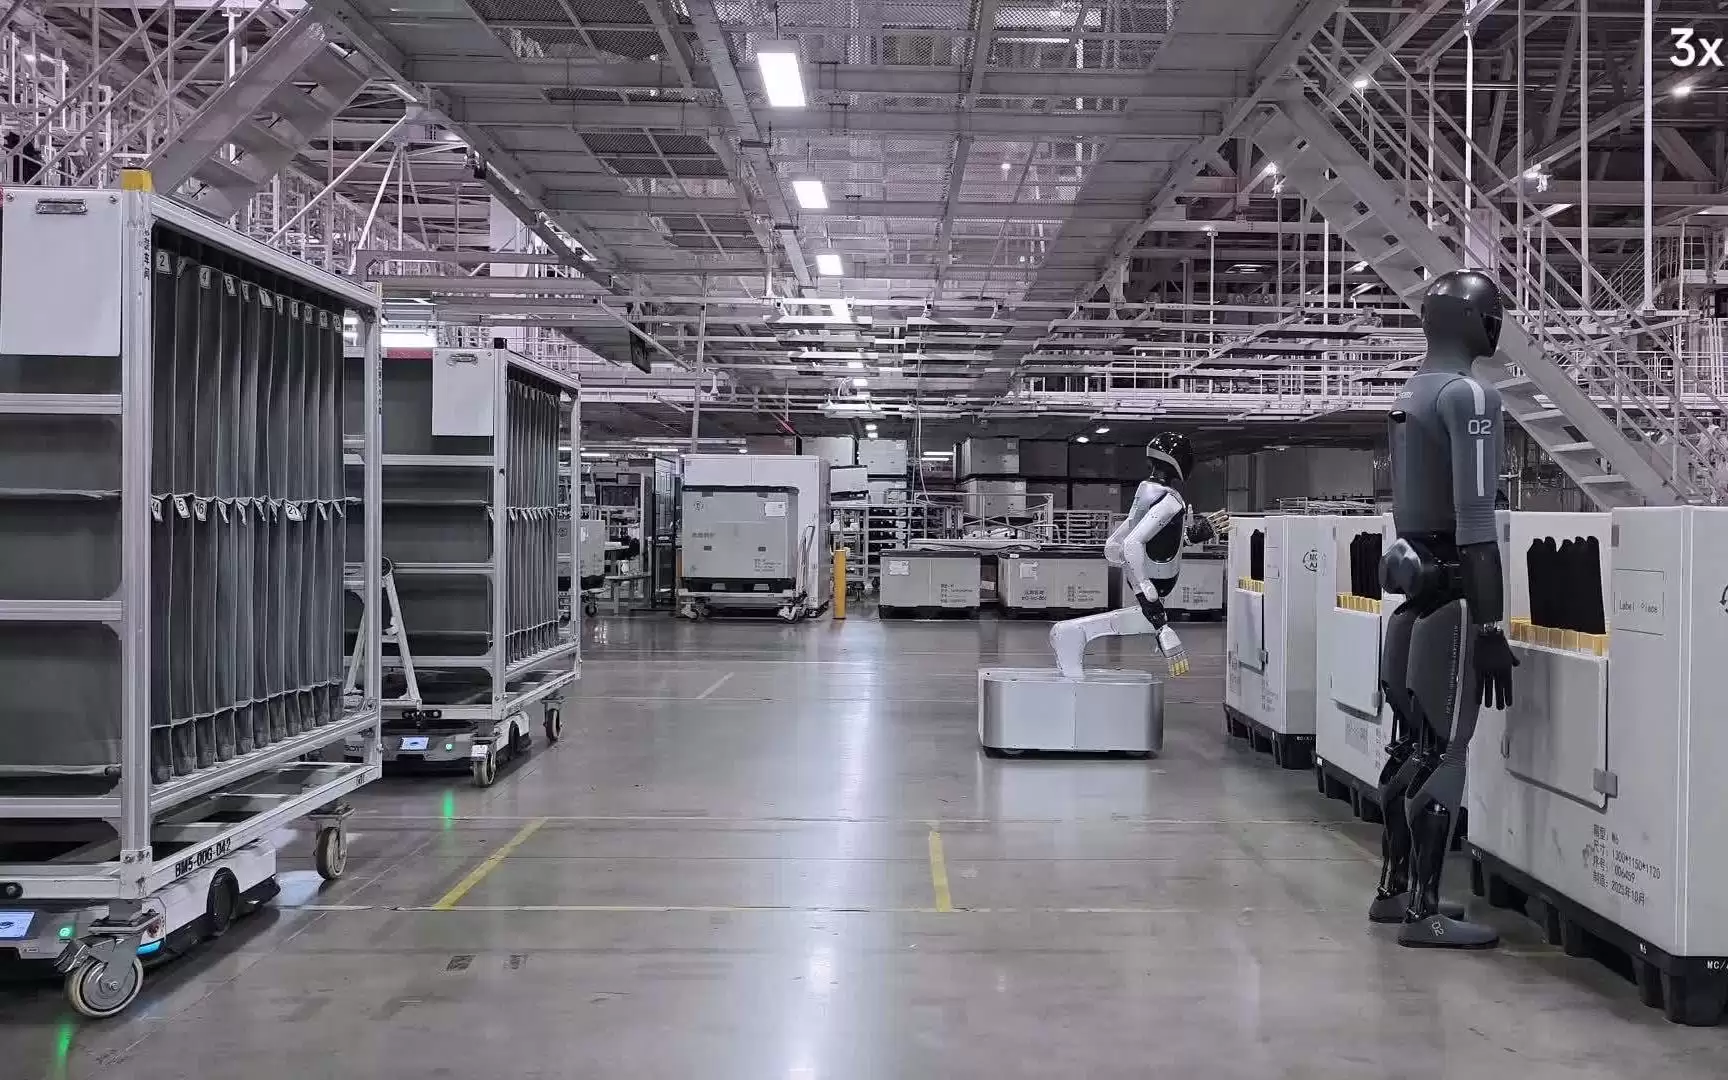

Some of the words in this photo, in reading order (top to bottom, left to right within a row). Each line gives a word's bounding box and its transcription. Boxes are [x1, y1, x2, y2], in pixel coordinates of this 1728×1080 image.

[159, 254, 165, 267] 2
[1468, 419, 1492, 435] 02
[1619, 600, 1635, 612] Label
